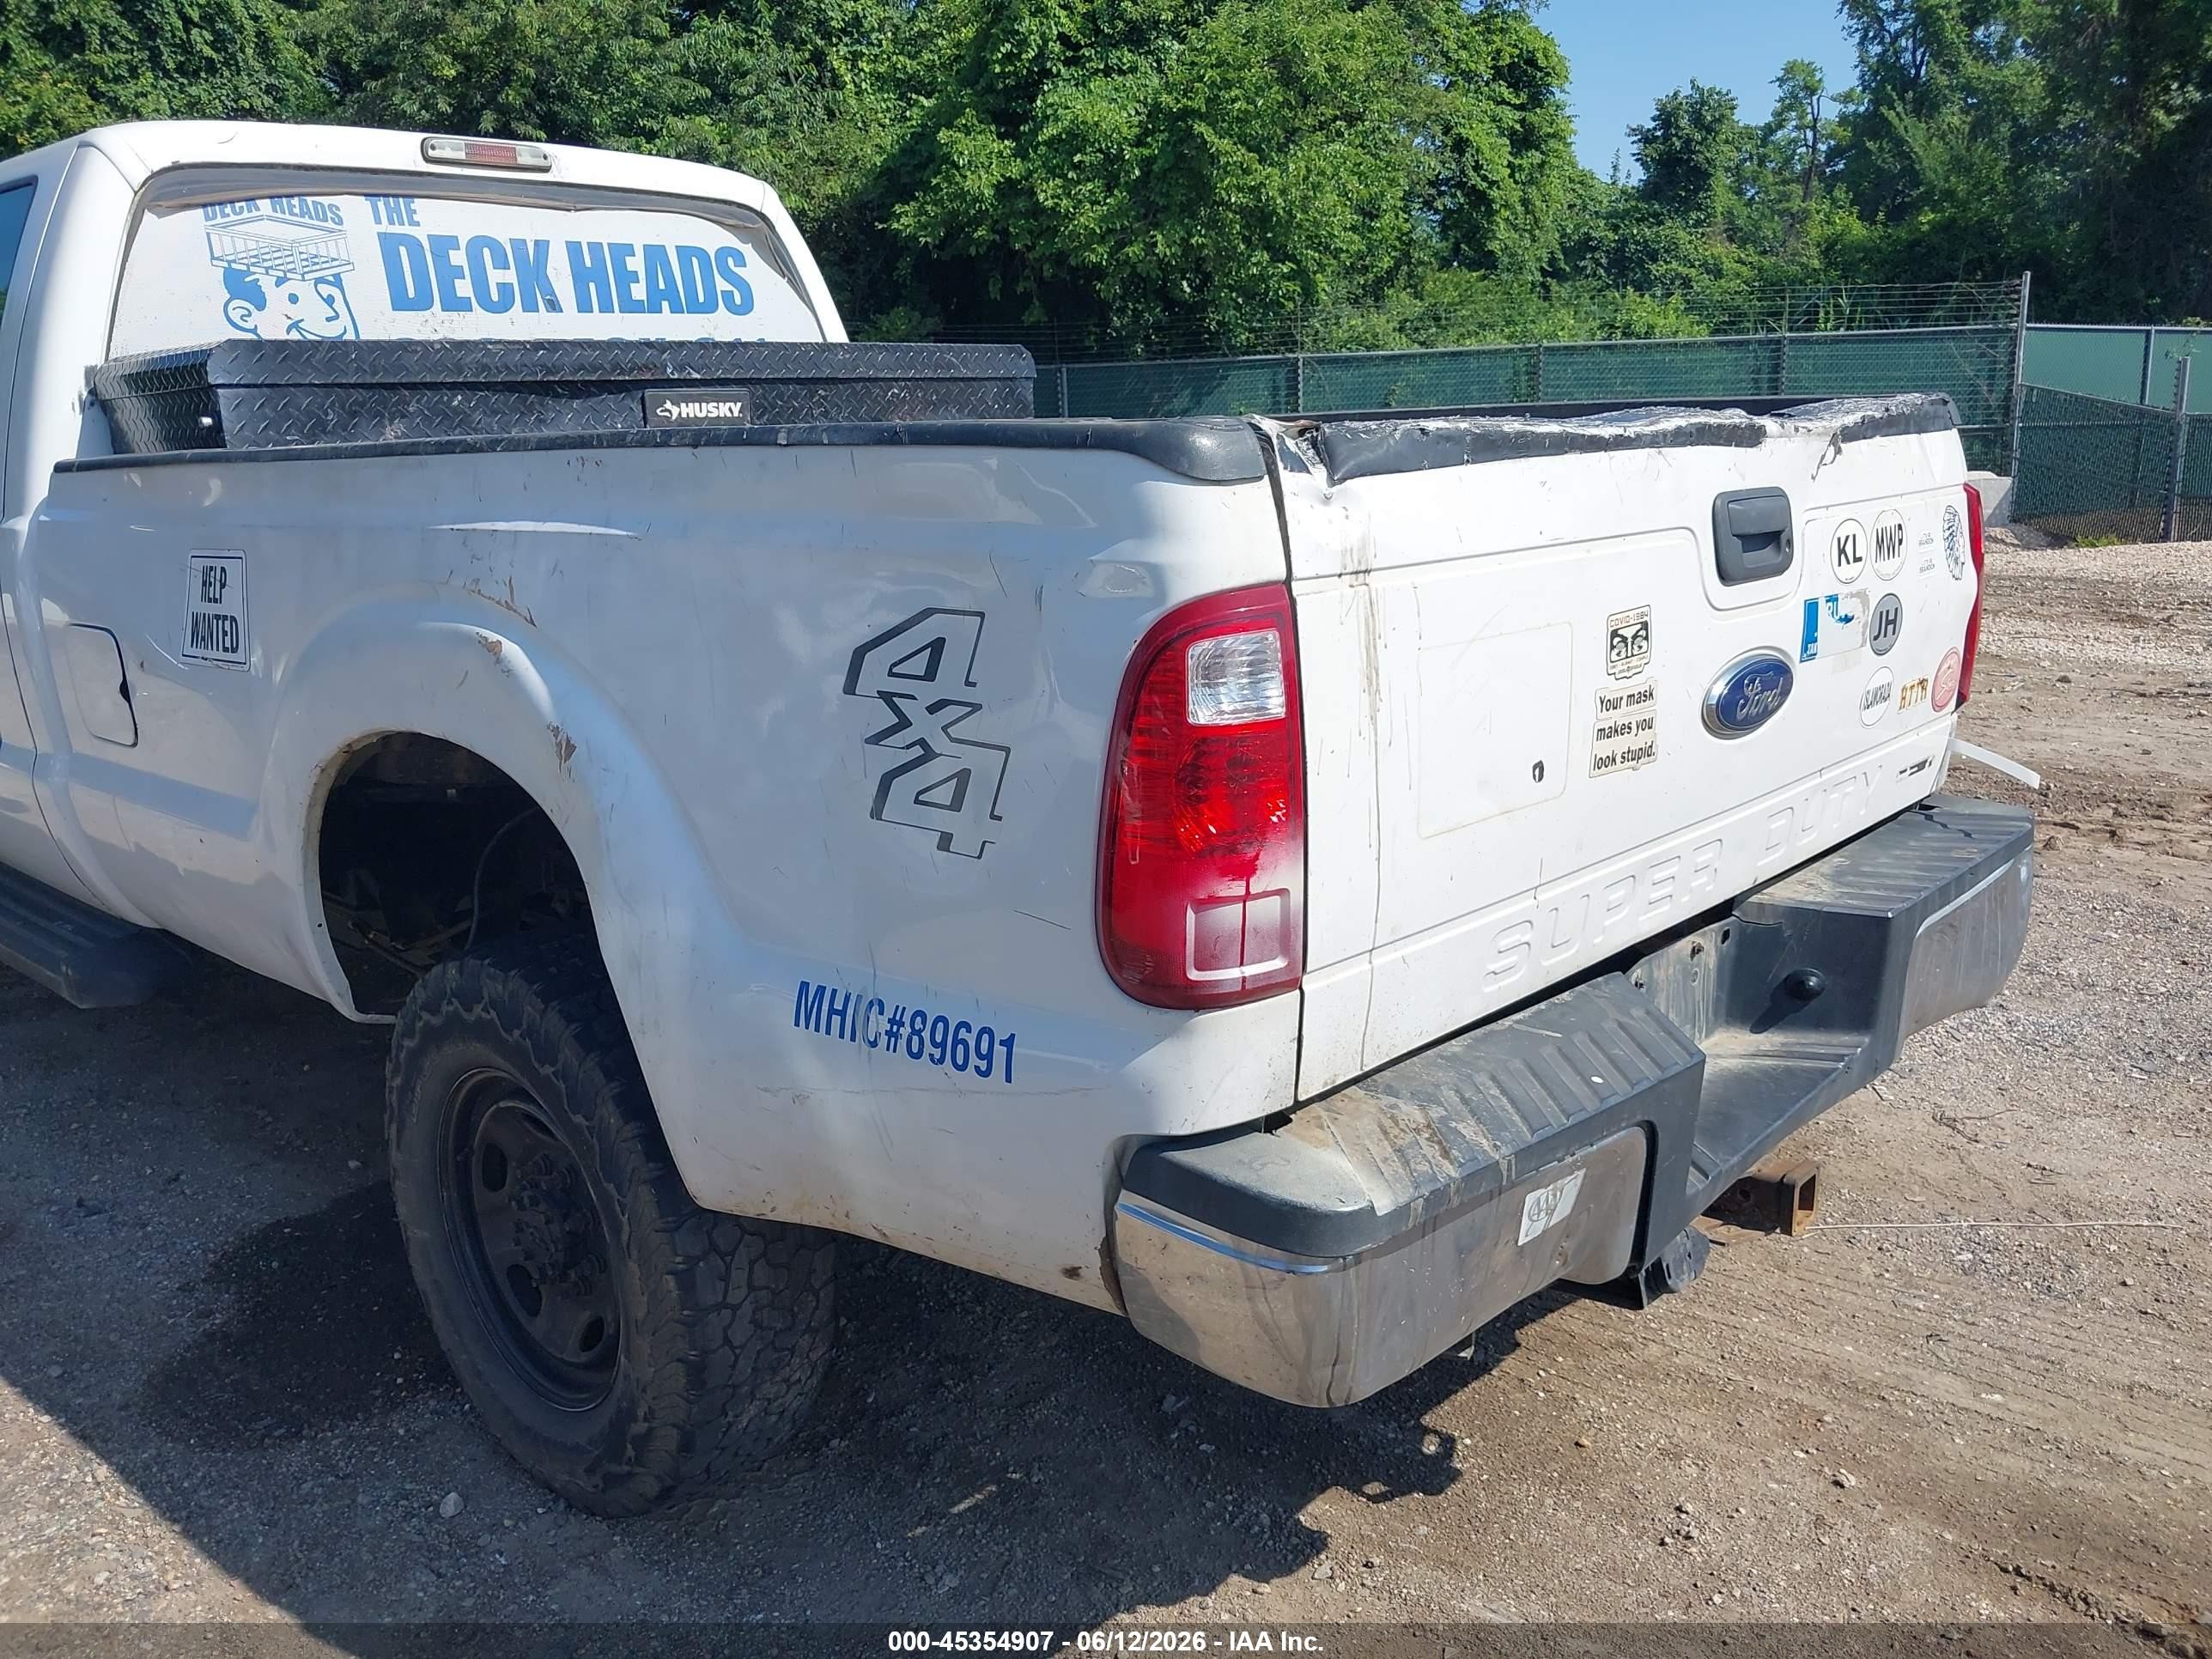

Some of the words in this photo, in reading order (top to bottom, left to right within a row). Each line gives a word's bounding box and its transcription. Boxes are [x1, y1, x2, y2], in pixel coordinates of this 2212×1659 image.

[202, 198, 260, 222] DECK
[270, 196, 345, 226] HEADS
[364, 194, 421, 228] THE
[376, 232, 563, 313] DECK
[565, 240, 754, 316] HEADS
[1837, 533, 1863, 568] KL
[1875, 523, 1903, 563] MWP
[201, 565, 227, 605] HELP
[191, 611, 239, 654] WANTED
[1873, 607, 1899, 641] JH
[1599, 694, 1624, 714] Your
[1626, 684, 1656, 708] mask
[1736, 671, 1784, 721] Ford
[1595, 720, 1632, 742] makes
[1634, 715, 1654, 737] you
[1593, 750, 1617, 771] look
[1620, 740, 1656, 764] stupid.
[1483, 836, 1724, 994] SUPER
[1757, 763, 1883, 866] DUTY
[793, 981, 1016, 1084] MHIC#89691
